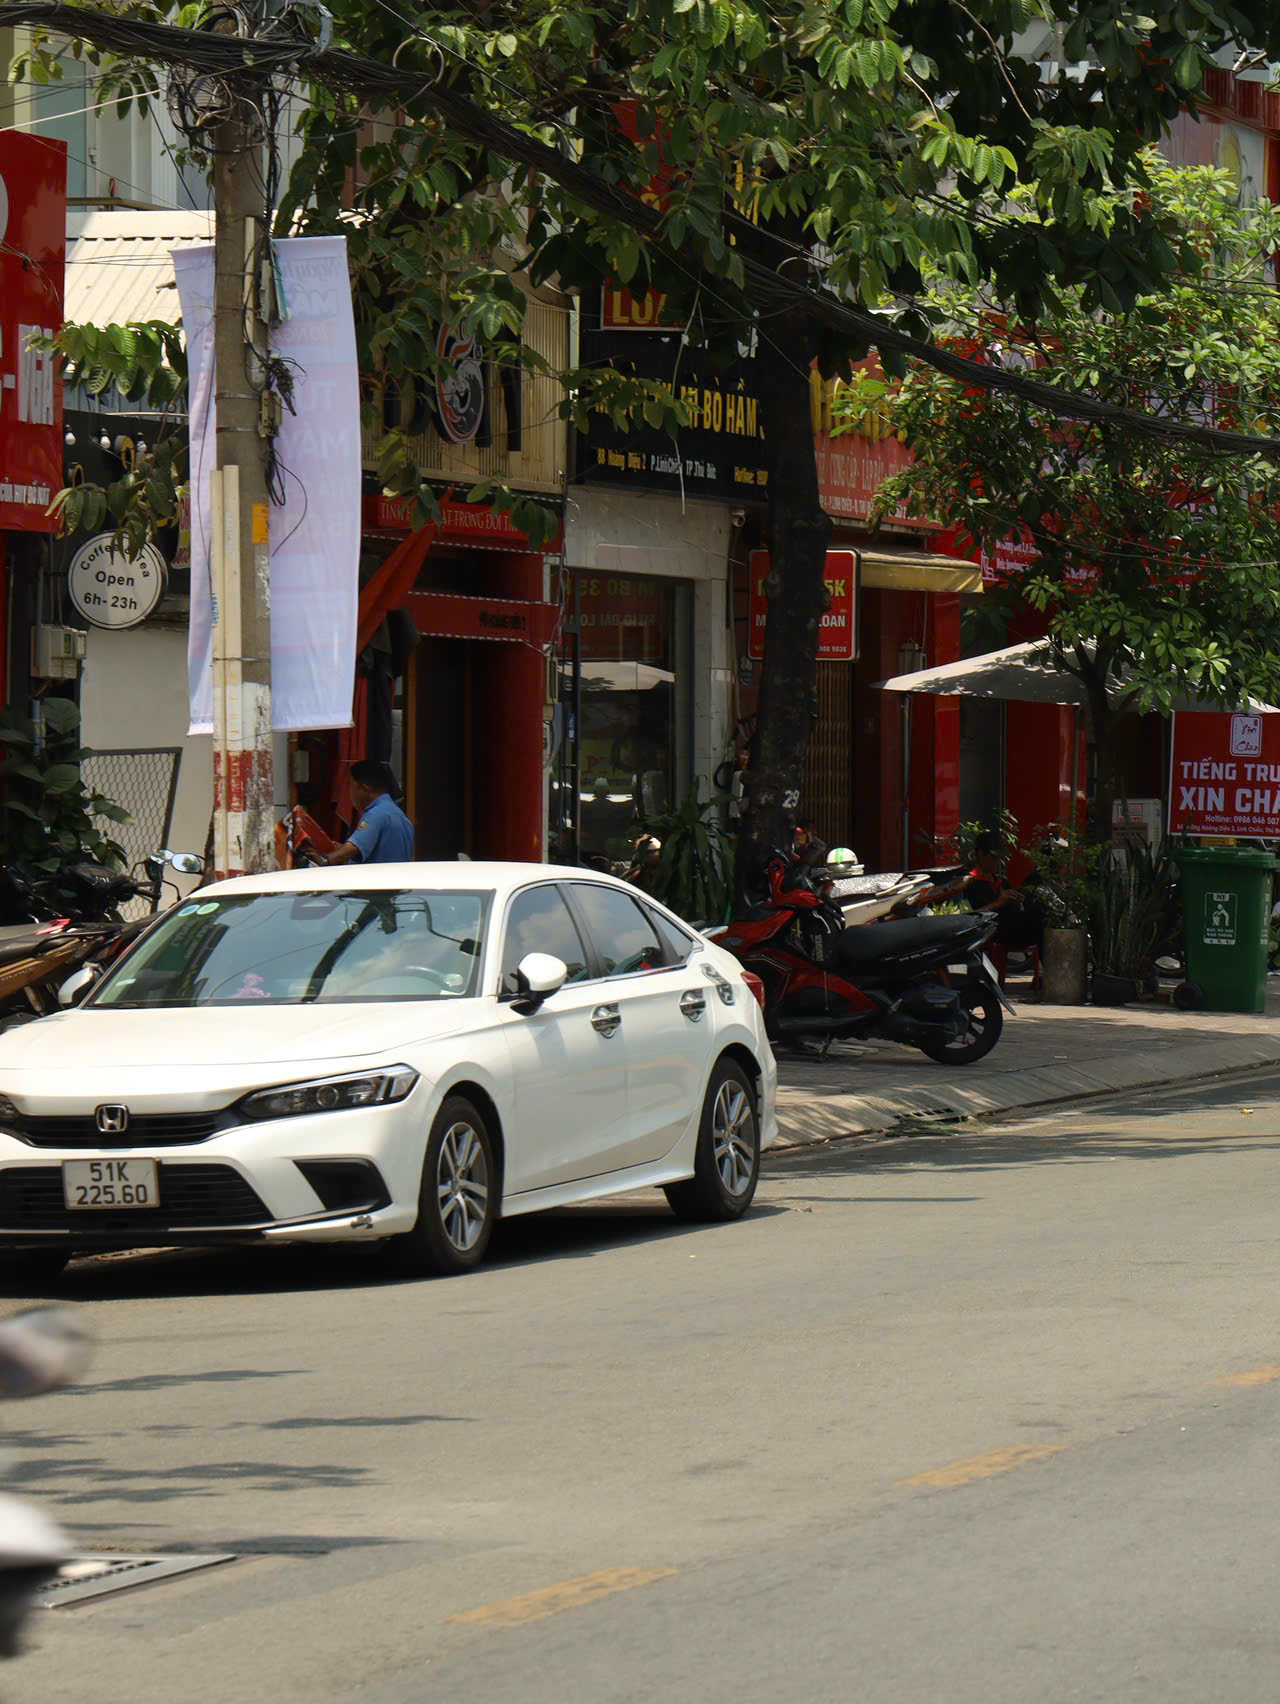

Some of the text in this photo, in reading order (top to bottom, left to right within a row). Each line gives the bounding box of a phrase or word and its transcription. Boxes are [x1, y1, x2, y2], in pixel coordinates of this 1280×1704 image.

[703, 376, 723, 432] BÒ
[135, 552, 150, 578] Tea
[95, 570, 135, 587] Open
[820, 615, 846, 628] OAN
[1180, 756, 1237, 780] TIẾNG
[782, 788, 801, 808] 29
[1179, 786, 1225, 812] XIN
[89, 1162, 129, 1182] 51K
[75, 1184, 148, 1206] 225.60
